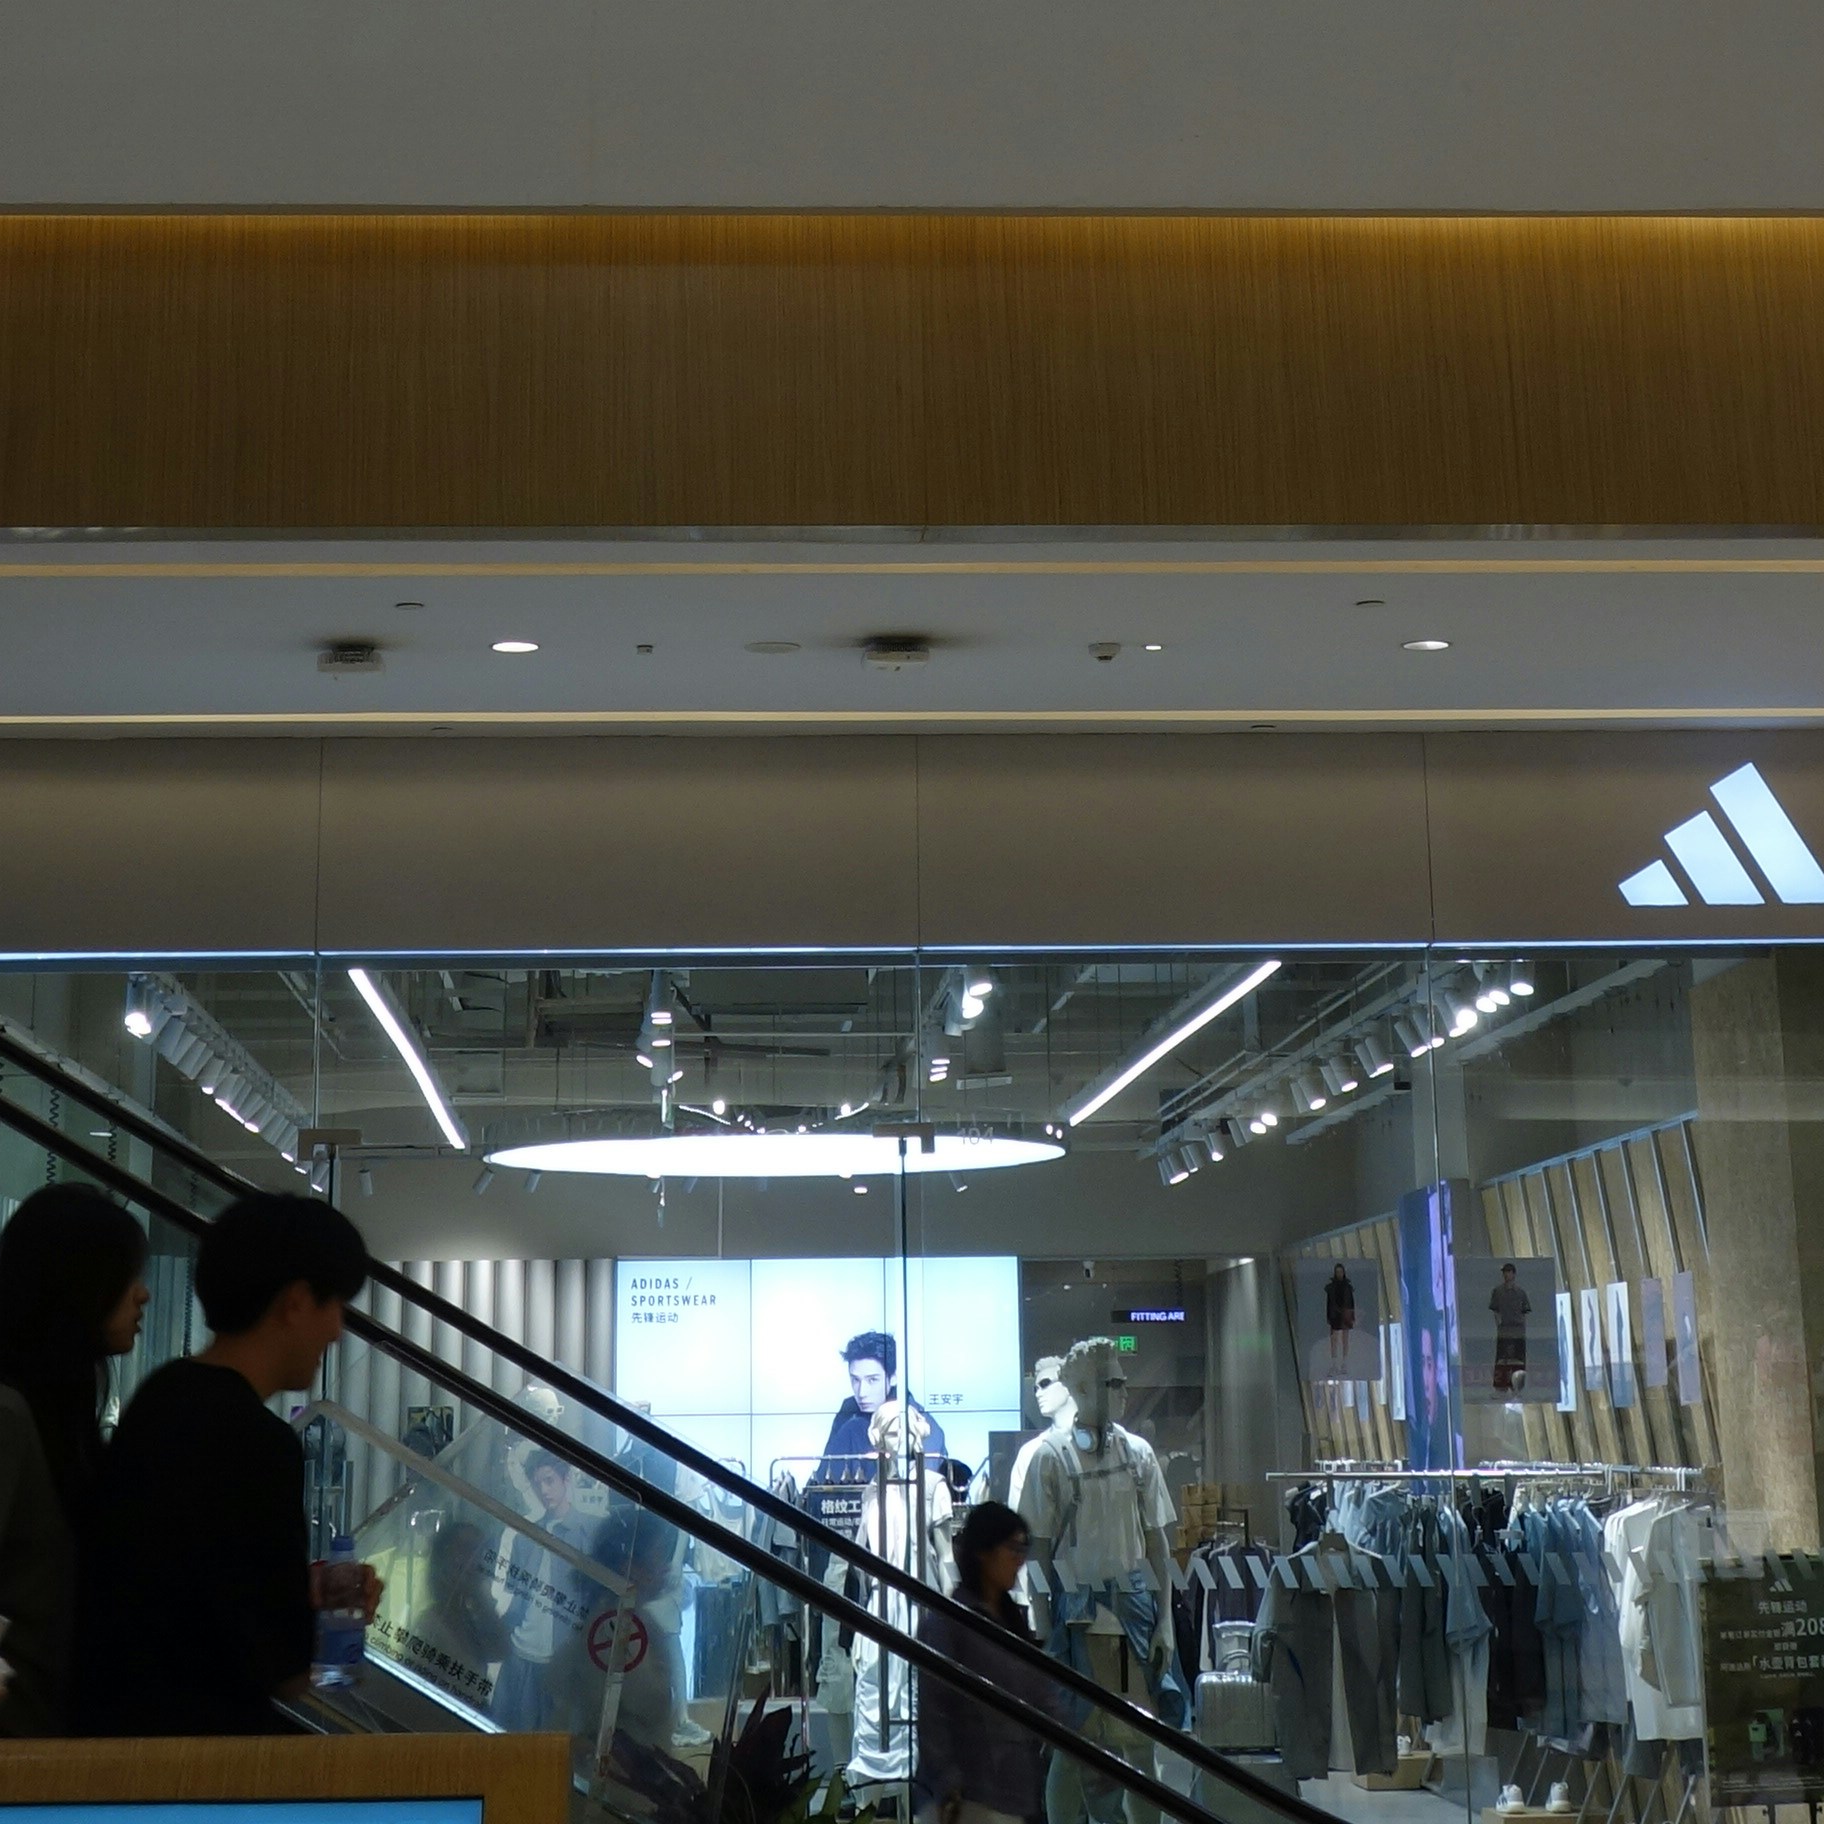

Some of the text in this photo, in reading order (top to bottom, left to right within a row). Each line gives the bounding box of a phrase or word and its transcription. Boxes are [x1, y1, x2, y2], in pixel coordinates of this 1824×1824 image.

[958, 1127, 994, 1145] 104
[631, 1278, 679, 1290] ADIDAS
[631, 1294, 716, 1307] SPORTSWEAR
[1130, 1312, 1167, 1322] FITTING
